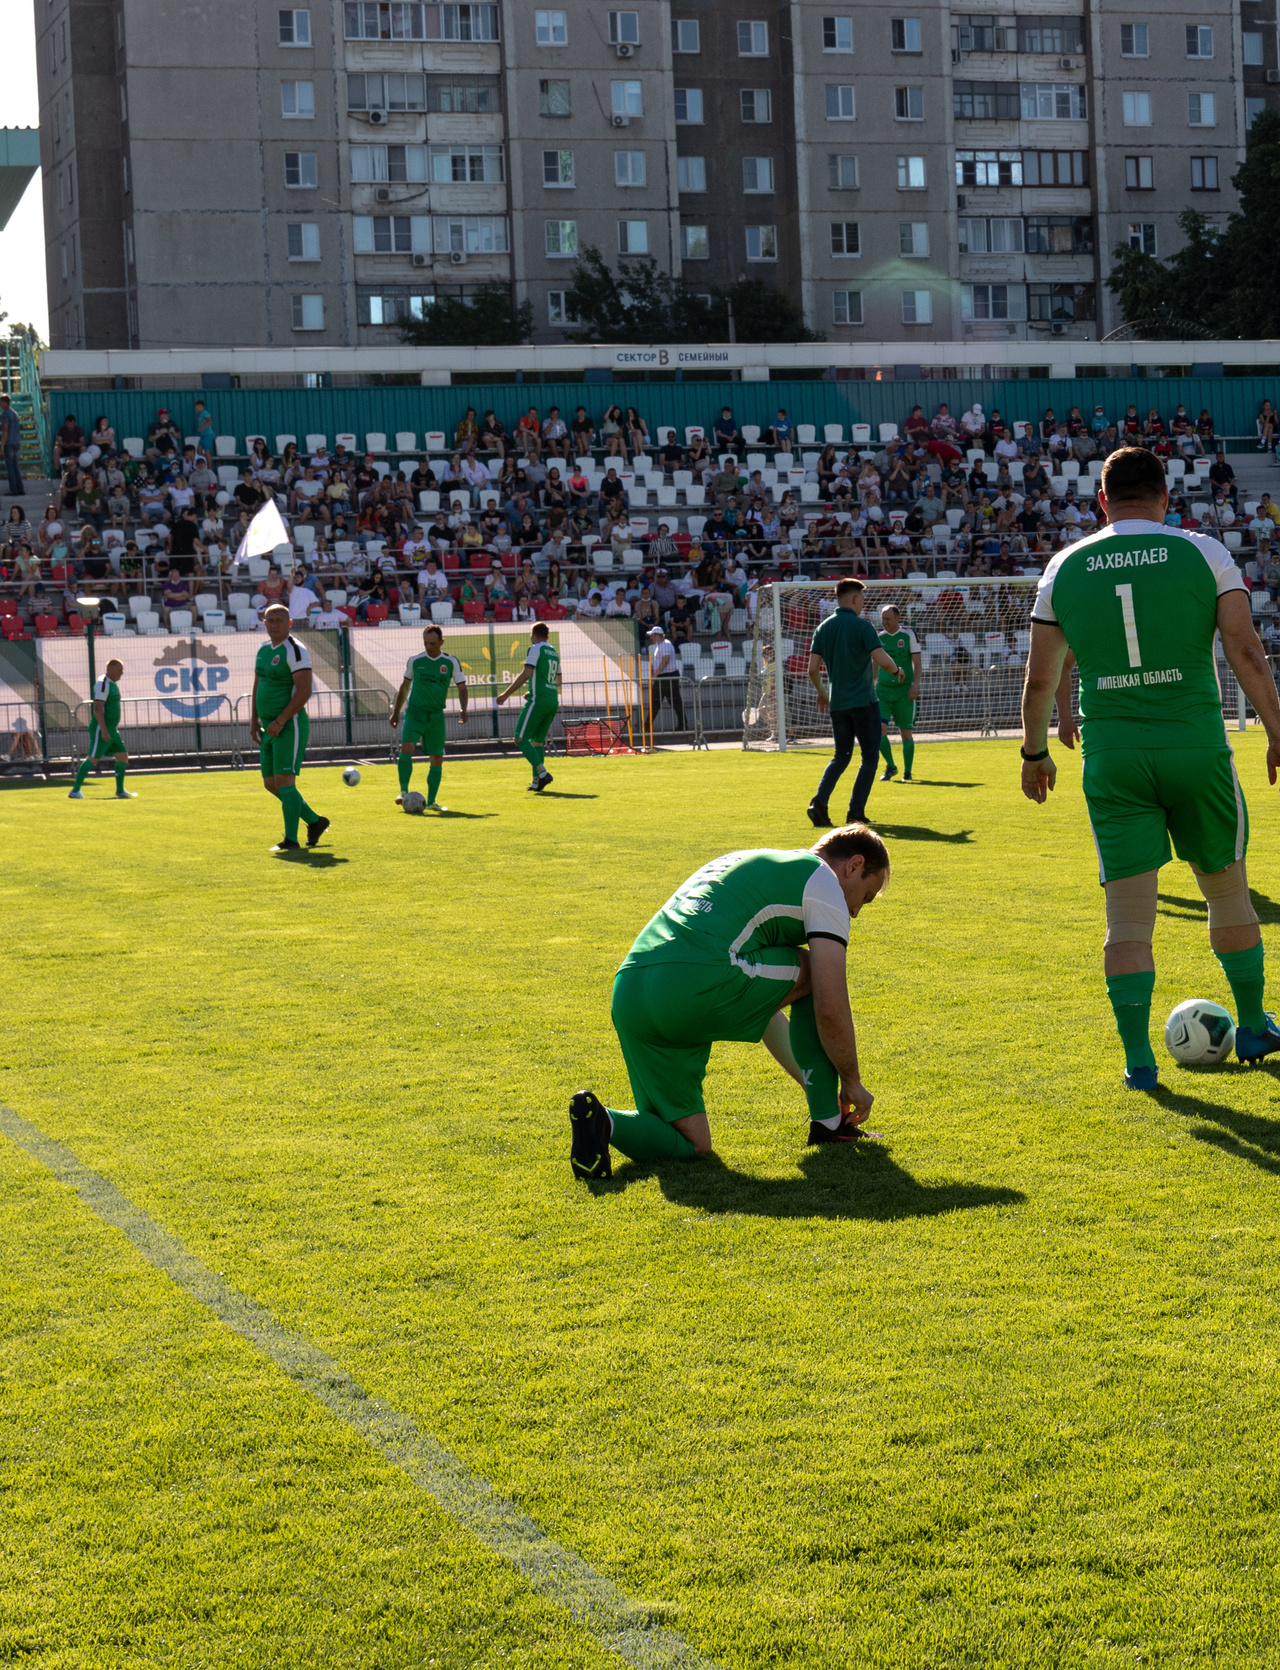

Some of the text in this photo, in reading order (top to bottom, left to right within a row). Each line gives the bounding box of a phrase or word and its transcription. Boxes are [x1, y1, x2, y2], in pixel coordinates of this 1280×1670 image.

[616, 349, 729, 365] СЕКТОР В СЕМЕЙНЫЙ
[1086, 547, 1168, 572] ЗАХВАТАЕВ
[1115, 583, 1142, 668] 1
[154, 666, 230, 693] СКР
[1097, 668, 1183, 690] ЛИПЕЦКАЯ ОБЛАСТЬ
